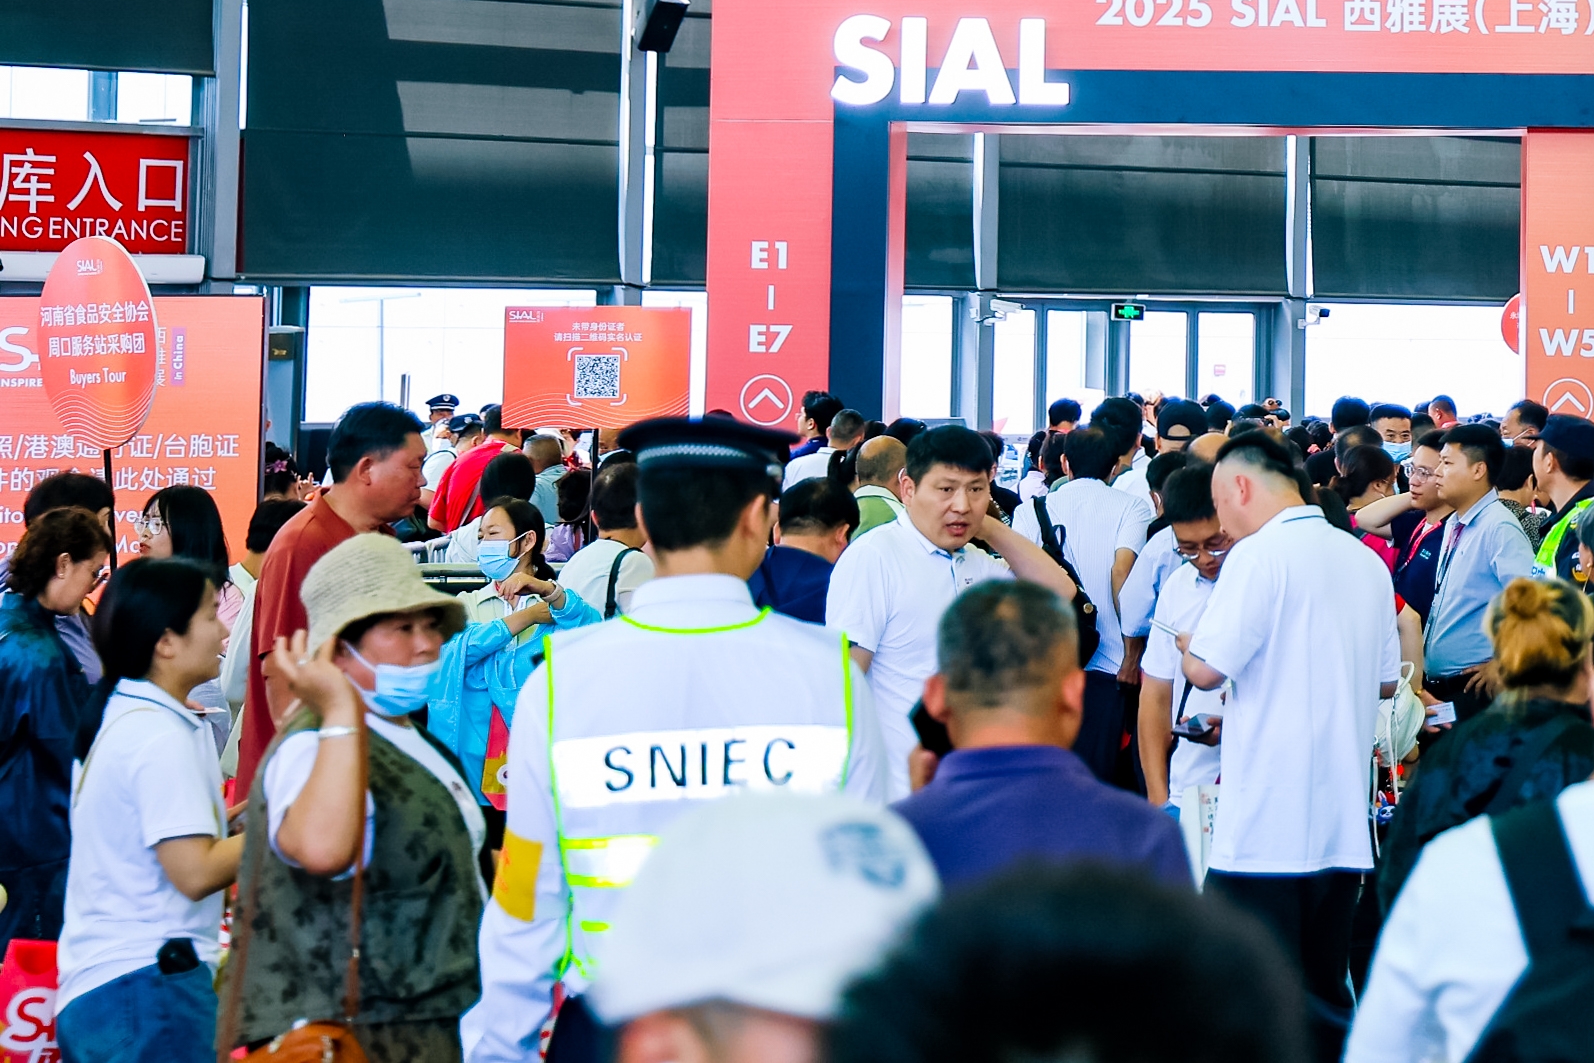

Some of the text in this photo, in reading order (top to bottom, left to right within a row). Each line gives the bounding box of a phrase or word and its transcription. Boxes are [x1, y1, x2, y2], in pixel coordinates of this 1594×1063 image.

[831, 14, 1071, 106] SIAL
[0, 147, 184, 214] 库入口
[49, 217, 184, 242] ENTRANCE
[76, 260, 97, 273] SIAL
[750, 240, 789, 270] E1
[40, 300, 150, 328] 河南省食品安全协会
[509, 310, 537, 321] SIAL
[572, 322, 626, 332] 未带身份证者
[48, 333, 146, 358] 周口服务站采购团
[553, 332, 643, 343] 请扫描二维码实名认证
[748, 323, 794, 354] E7
[173, 336, 184, 370] China
[70, 367, 127, 388] Buyers Tour
[604, 738, 798, 793] SNIEC
